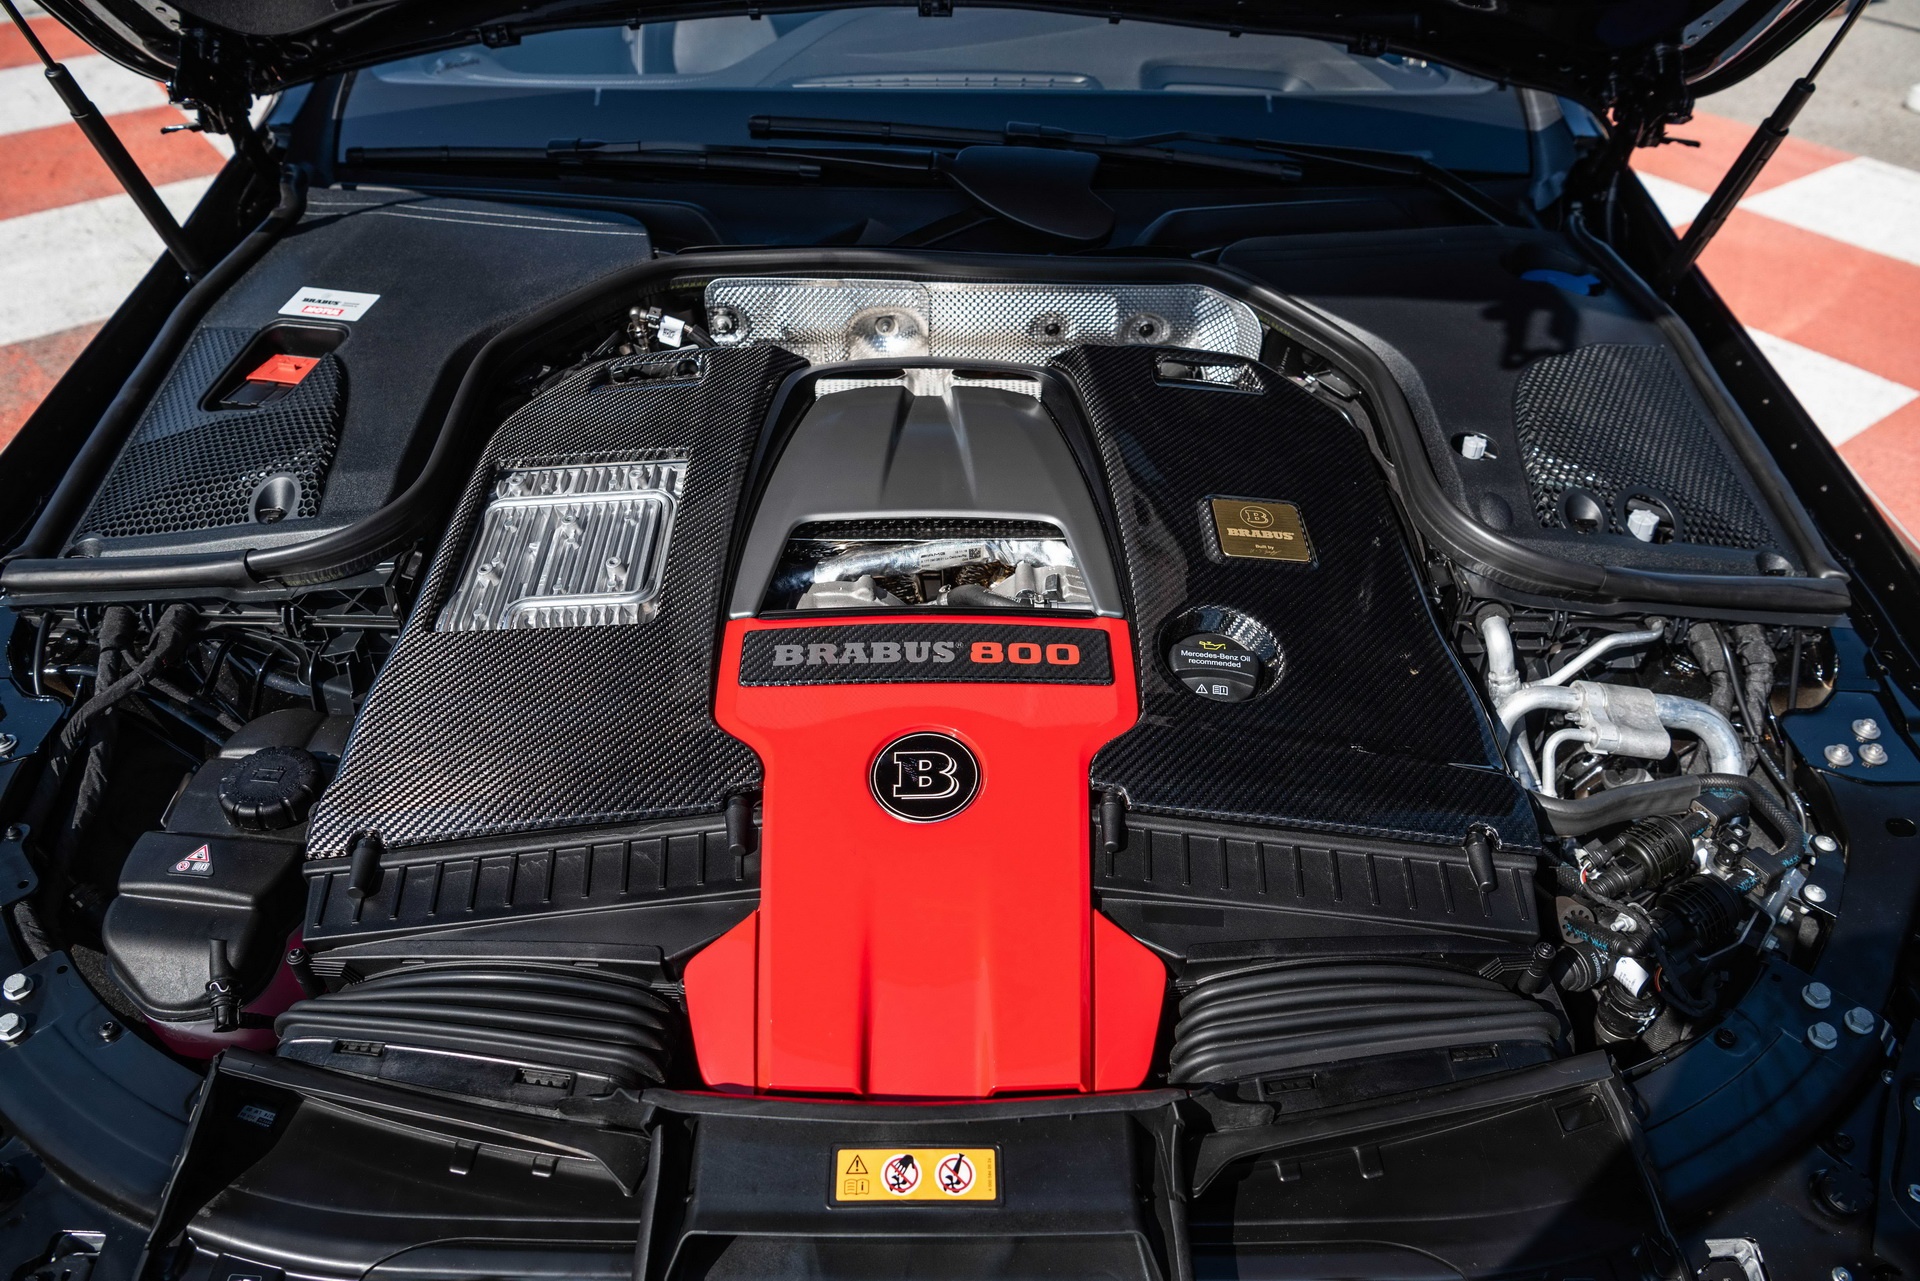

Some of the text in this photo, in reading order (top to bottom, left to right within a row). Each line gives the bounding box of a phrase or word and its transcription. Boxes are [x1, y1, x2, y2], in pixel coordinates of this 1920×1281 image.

[302, 297, 340, 306] BRABUS
[304, 306, 342, 316] MOTUL
[1226, 527, 1295, 541] BRABUS
[969, 642, 1081, 666] 800
[1180, 649, 1251, 663] Mercedes-Benz Oil
[1188, 658, 1242, 668] recommended
[893, 751, 960, 800] B
